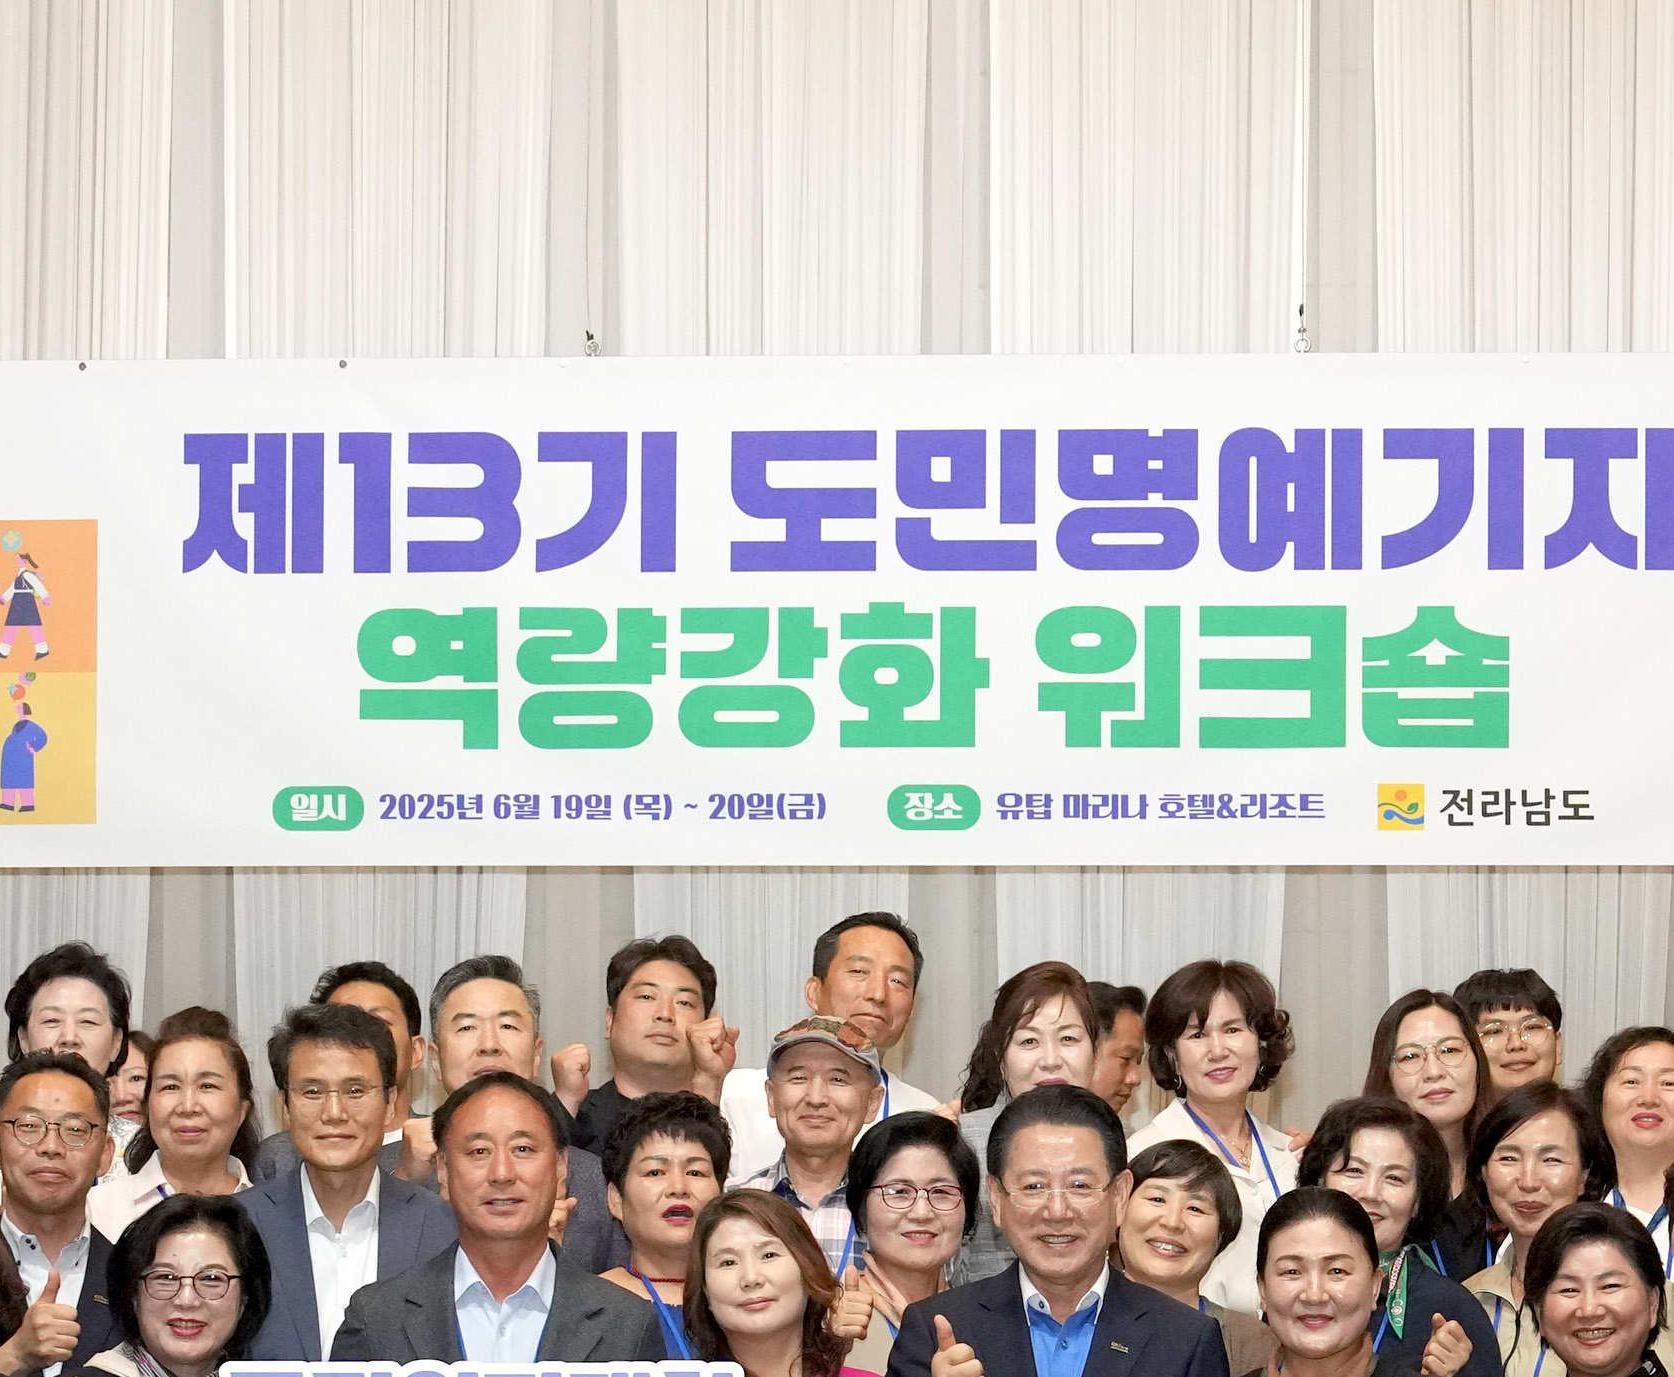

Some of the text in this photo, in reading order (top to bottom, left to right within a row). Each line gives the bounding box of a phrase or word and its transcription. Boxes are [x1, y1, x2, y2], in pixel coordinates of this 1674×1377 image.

[183, 432, 676, 574] 제13기
[357, 602, 1510, 749] 역량강화 워크숍
[290, 793, 347, 822] 일시
[380, 794, 482, 819] 2025년
[494, 795, 539, 819] 6월
[553, 795, 611, 819] 19일
[624, 795, 672, 820] (목)
[709, 794, 825, 819] 20일(금)
[903, 792, 1323, 821] 장소 유탑 마리나 호텔&리조트
[1440, 789, 1594, 826] 전라남도
